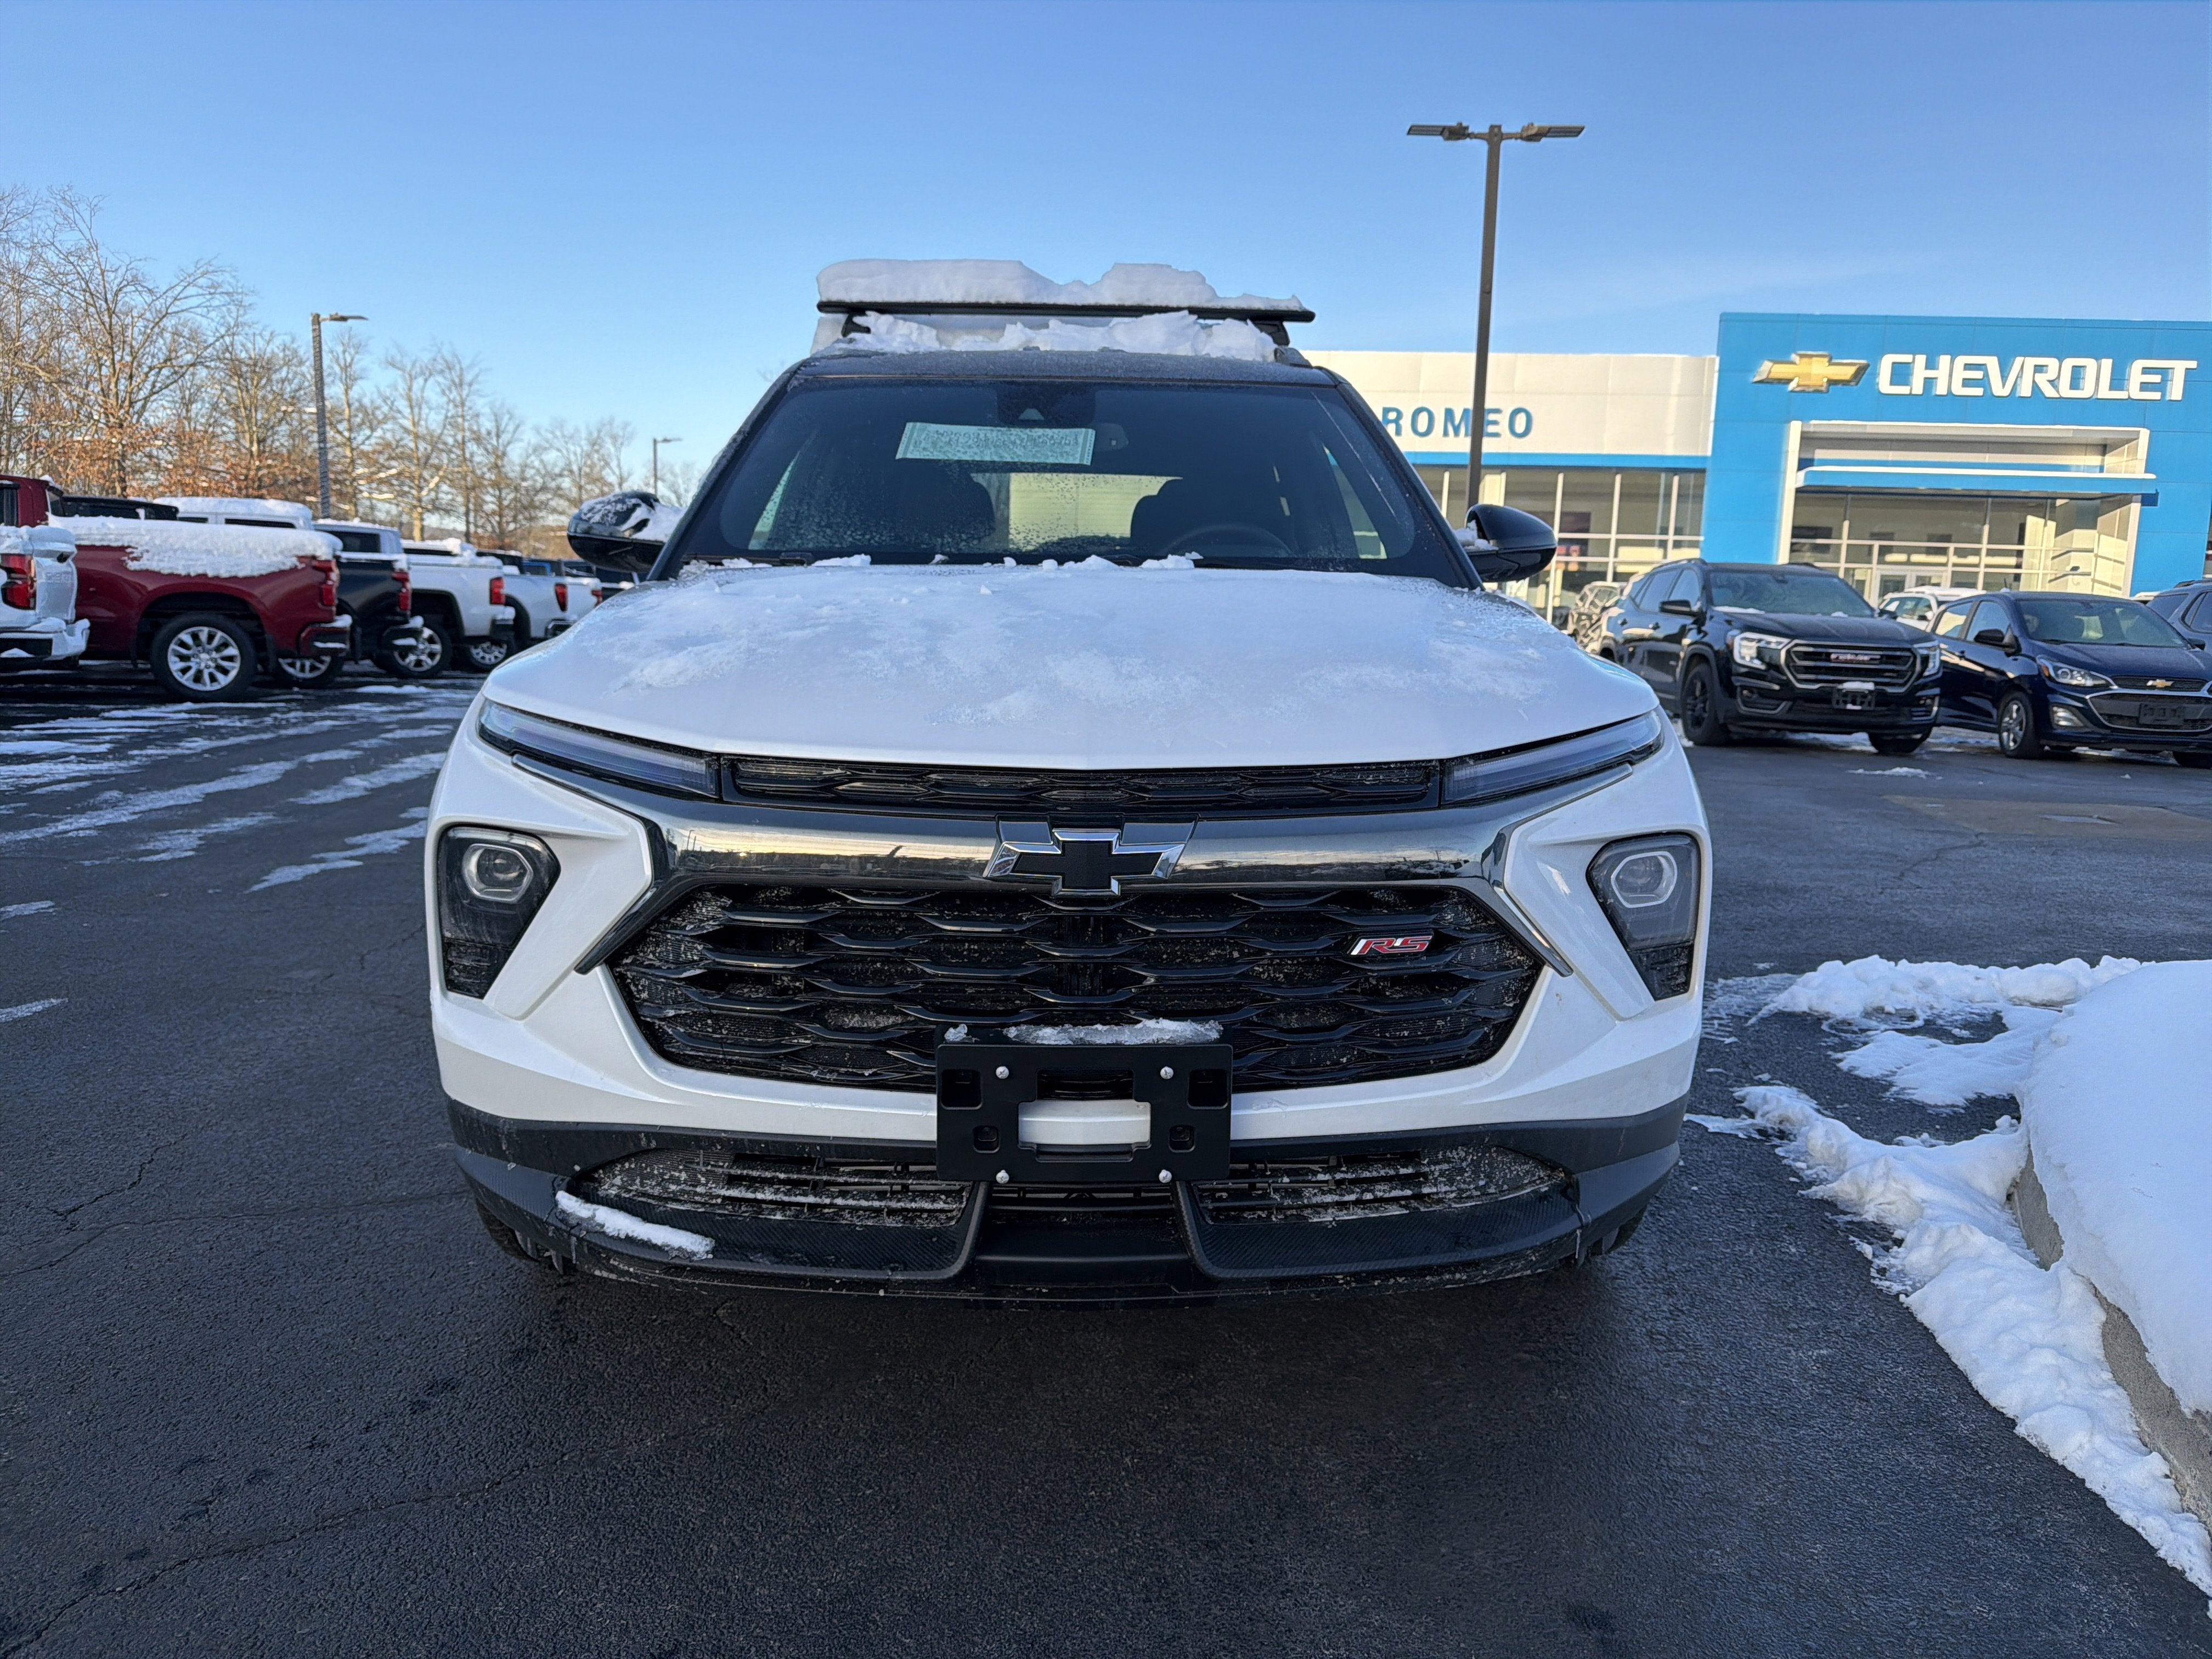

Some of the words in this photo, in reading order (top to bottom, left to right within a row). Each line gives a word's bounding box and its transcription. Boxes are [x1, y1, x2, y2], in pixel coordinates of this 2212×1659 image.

[1878, 354, 2198, 400] CHEVROLET
[1381, 407, 1533, 438] ROMEO
[1350, 935, 1432, 955] RS
